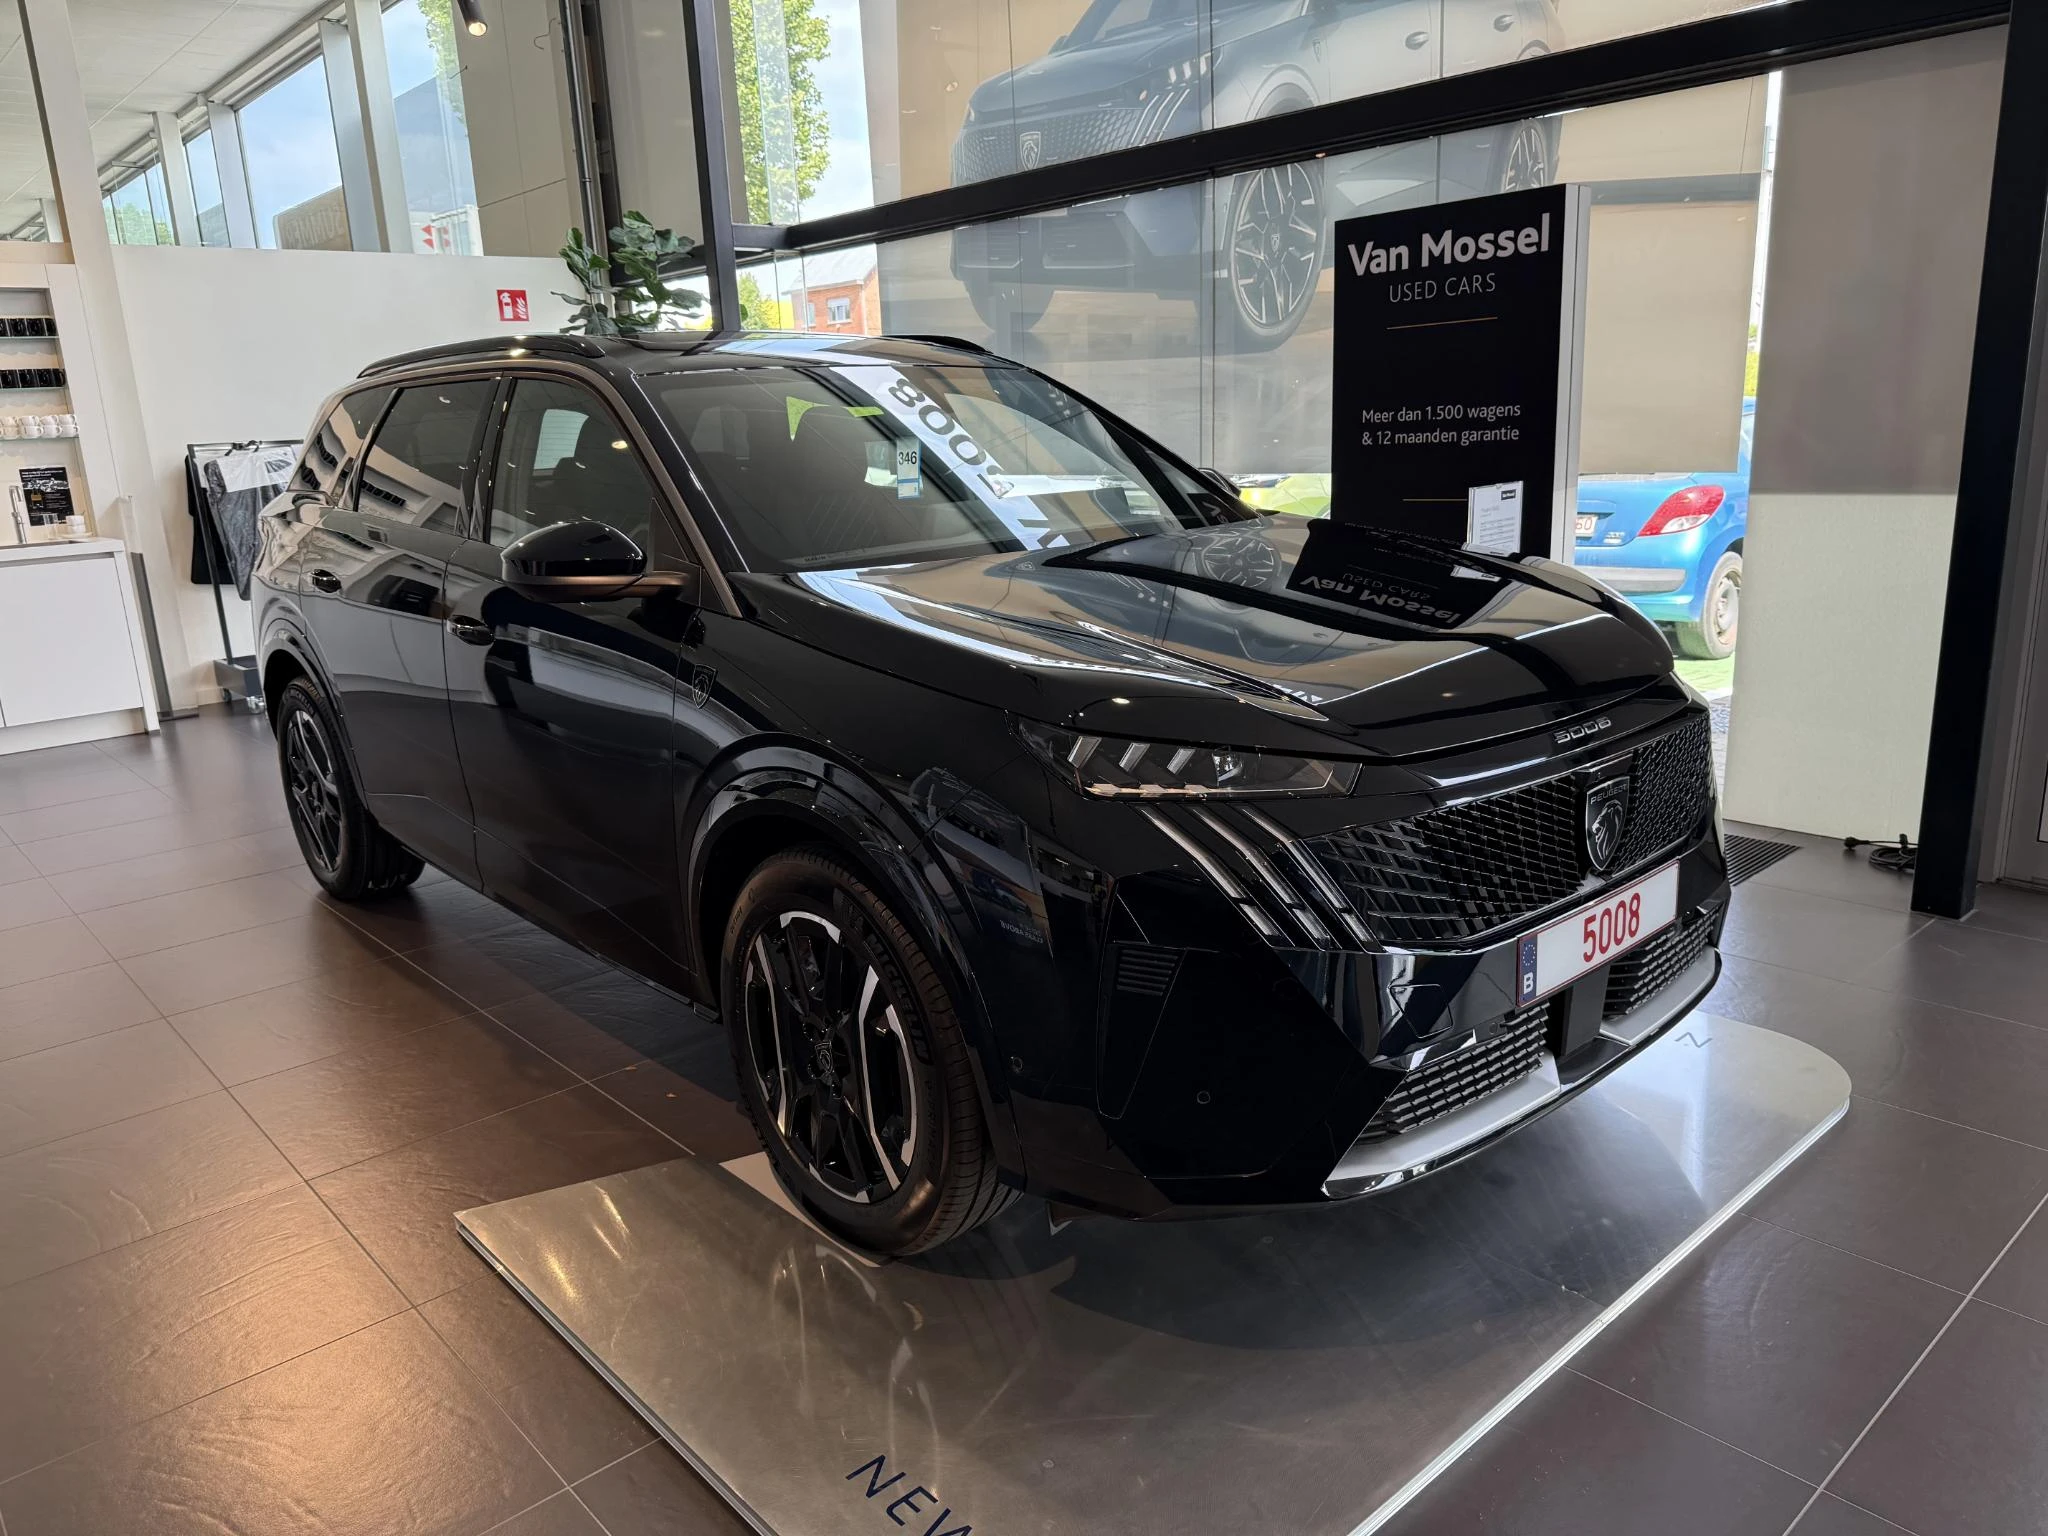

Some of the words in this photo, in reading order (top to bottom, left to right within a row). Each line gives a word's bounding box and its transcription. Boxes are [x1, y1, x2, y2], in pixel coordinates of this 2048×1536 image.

[1348, 241, 1409, 276] Van
[1421, 212, 1550, 268] Mossel
[1389, 280, 1437, 303] USED
[1445, 272, 1496, 296] CARS
[1362, 409, 1394, 424] Meer
[1397, 406, 1421, 421] dan
[1425, 404, 1463, 420] 1.500
[1467, 404, 1521, 422] wagens
[1361, 431, 1373, 446] &
[1376, 430, 1391, 445] 12
[1394, 428, 1457, 444] maanden
[1461, 425, 1520, 446] garantie
[898, 451, 917, 465] 346
[1553, 716, 1612, 743] 5008
[1590, 783, 1628, 804] PEUGEOT
[1583, 892, 1641, 963] 5008
[1523, 972, 1534, 995] B
[866, 932, 931, 1062] MICHELIN
